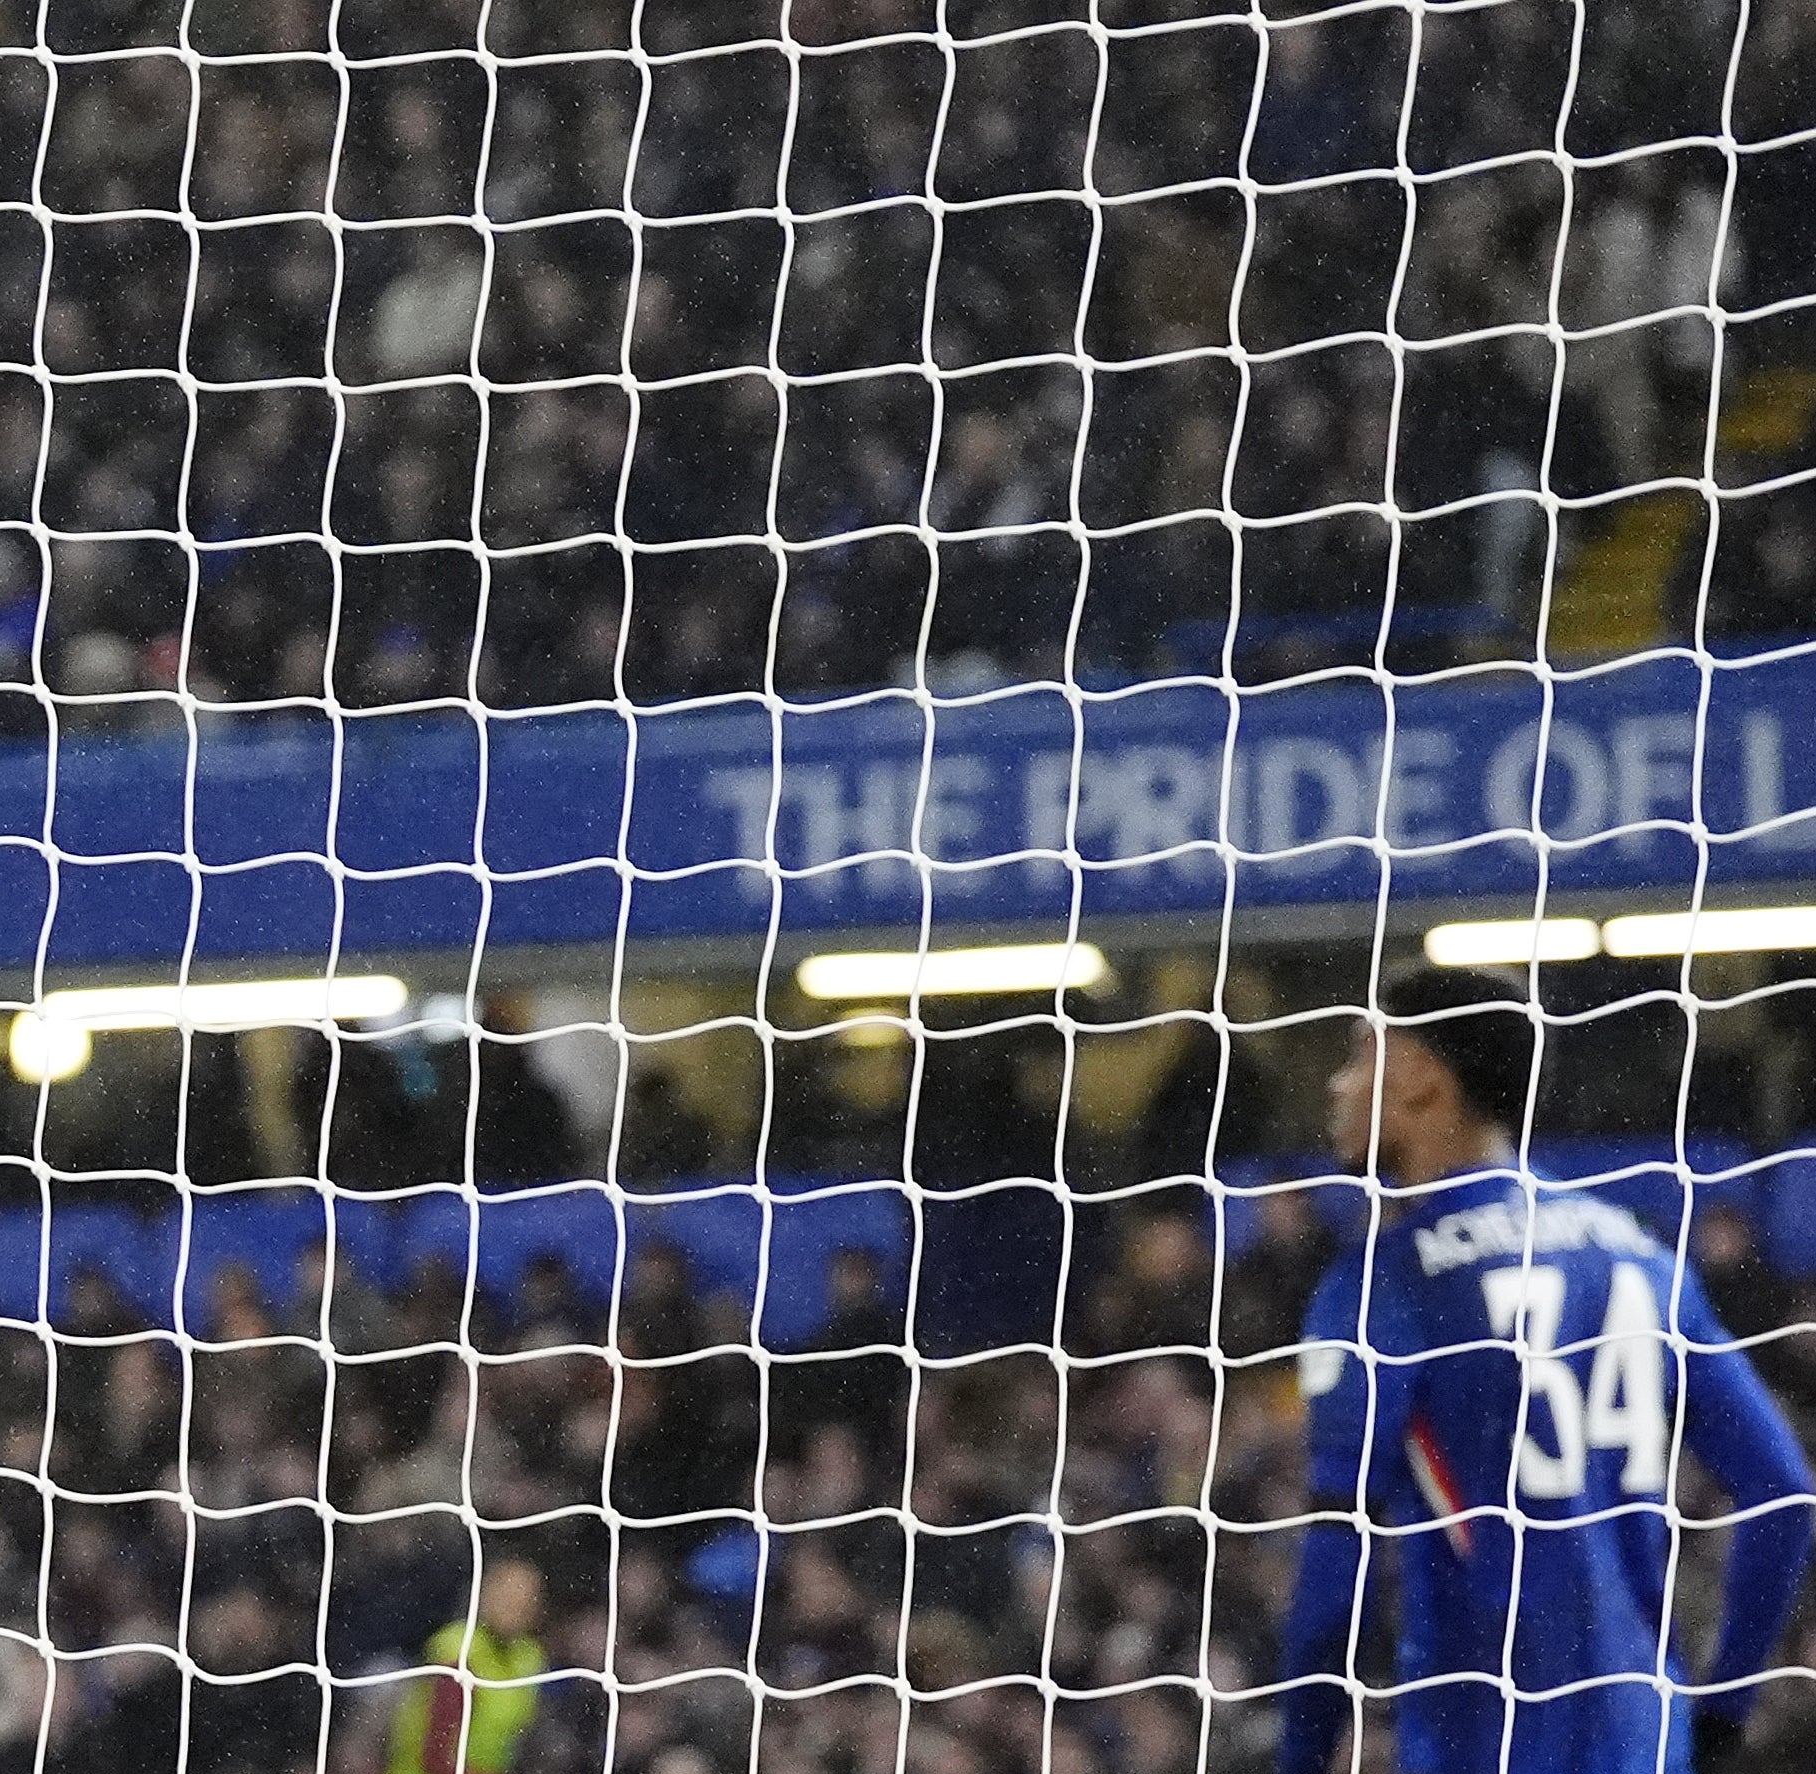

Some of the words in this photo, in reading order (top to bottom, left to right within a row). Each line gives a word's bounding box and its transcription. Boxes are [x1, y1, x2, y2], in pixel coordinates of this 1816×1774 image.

[708, 752, 994, 902] THE
[1021, 726, 1463, 888] PRIDE
[1486, 708, 1694, 866] OF
[1480, 1263, 1666, 1499] 34
